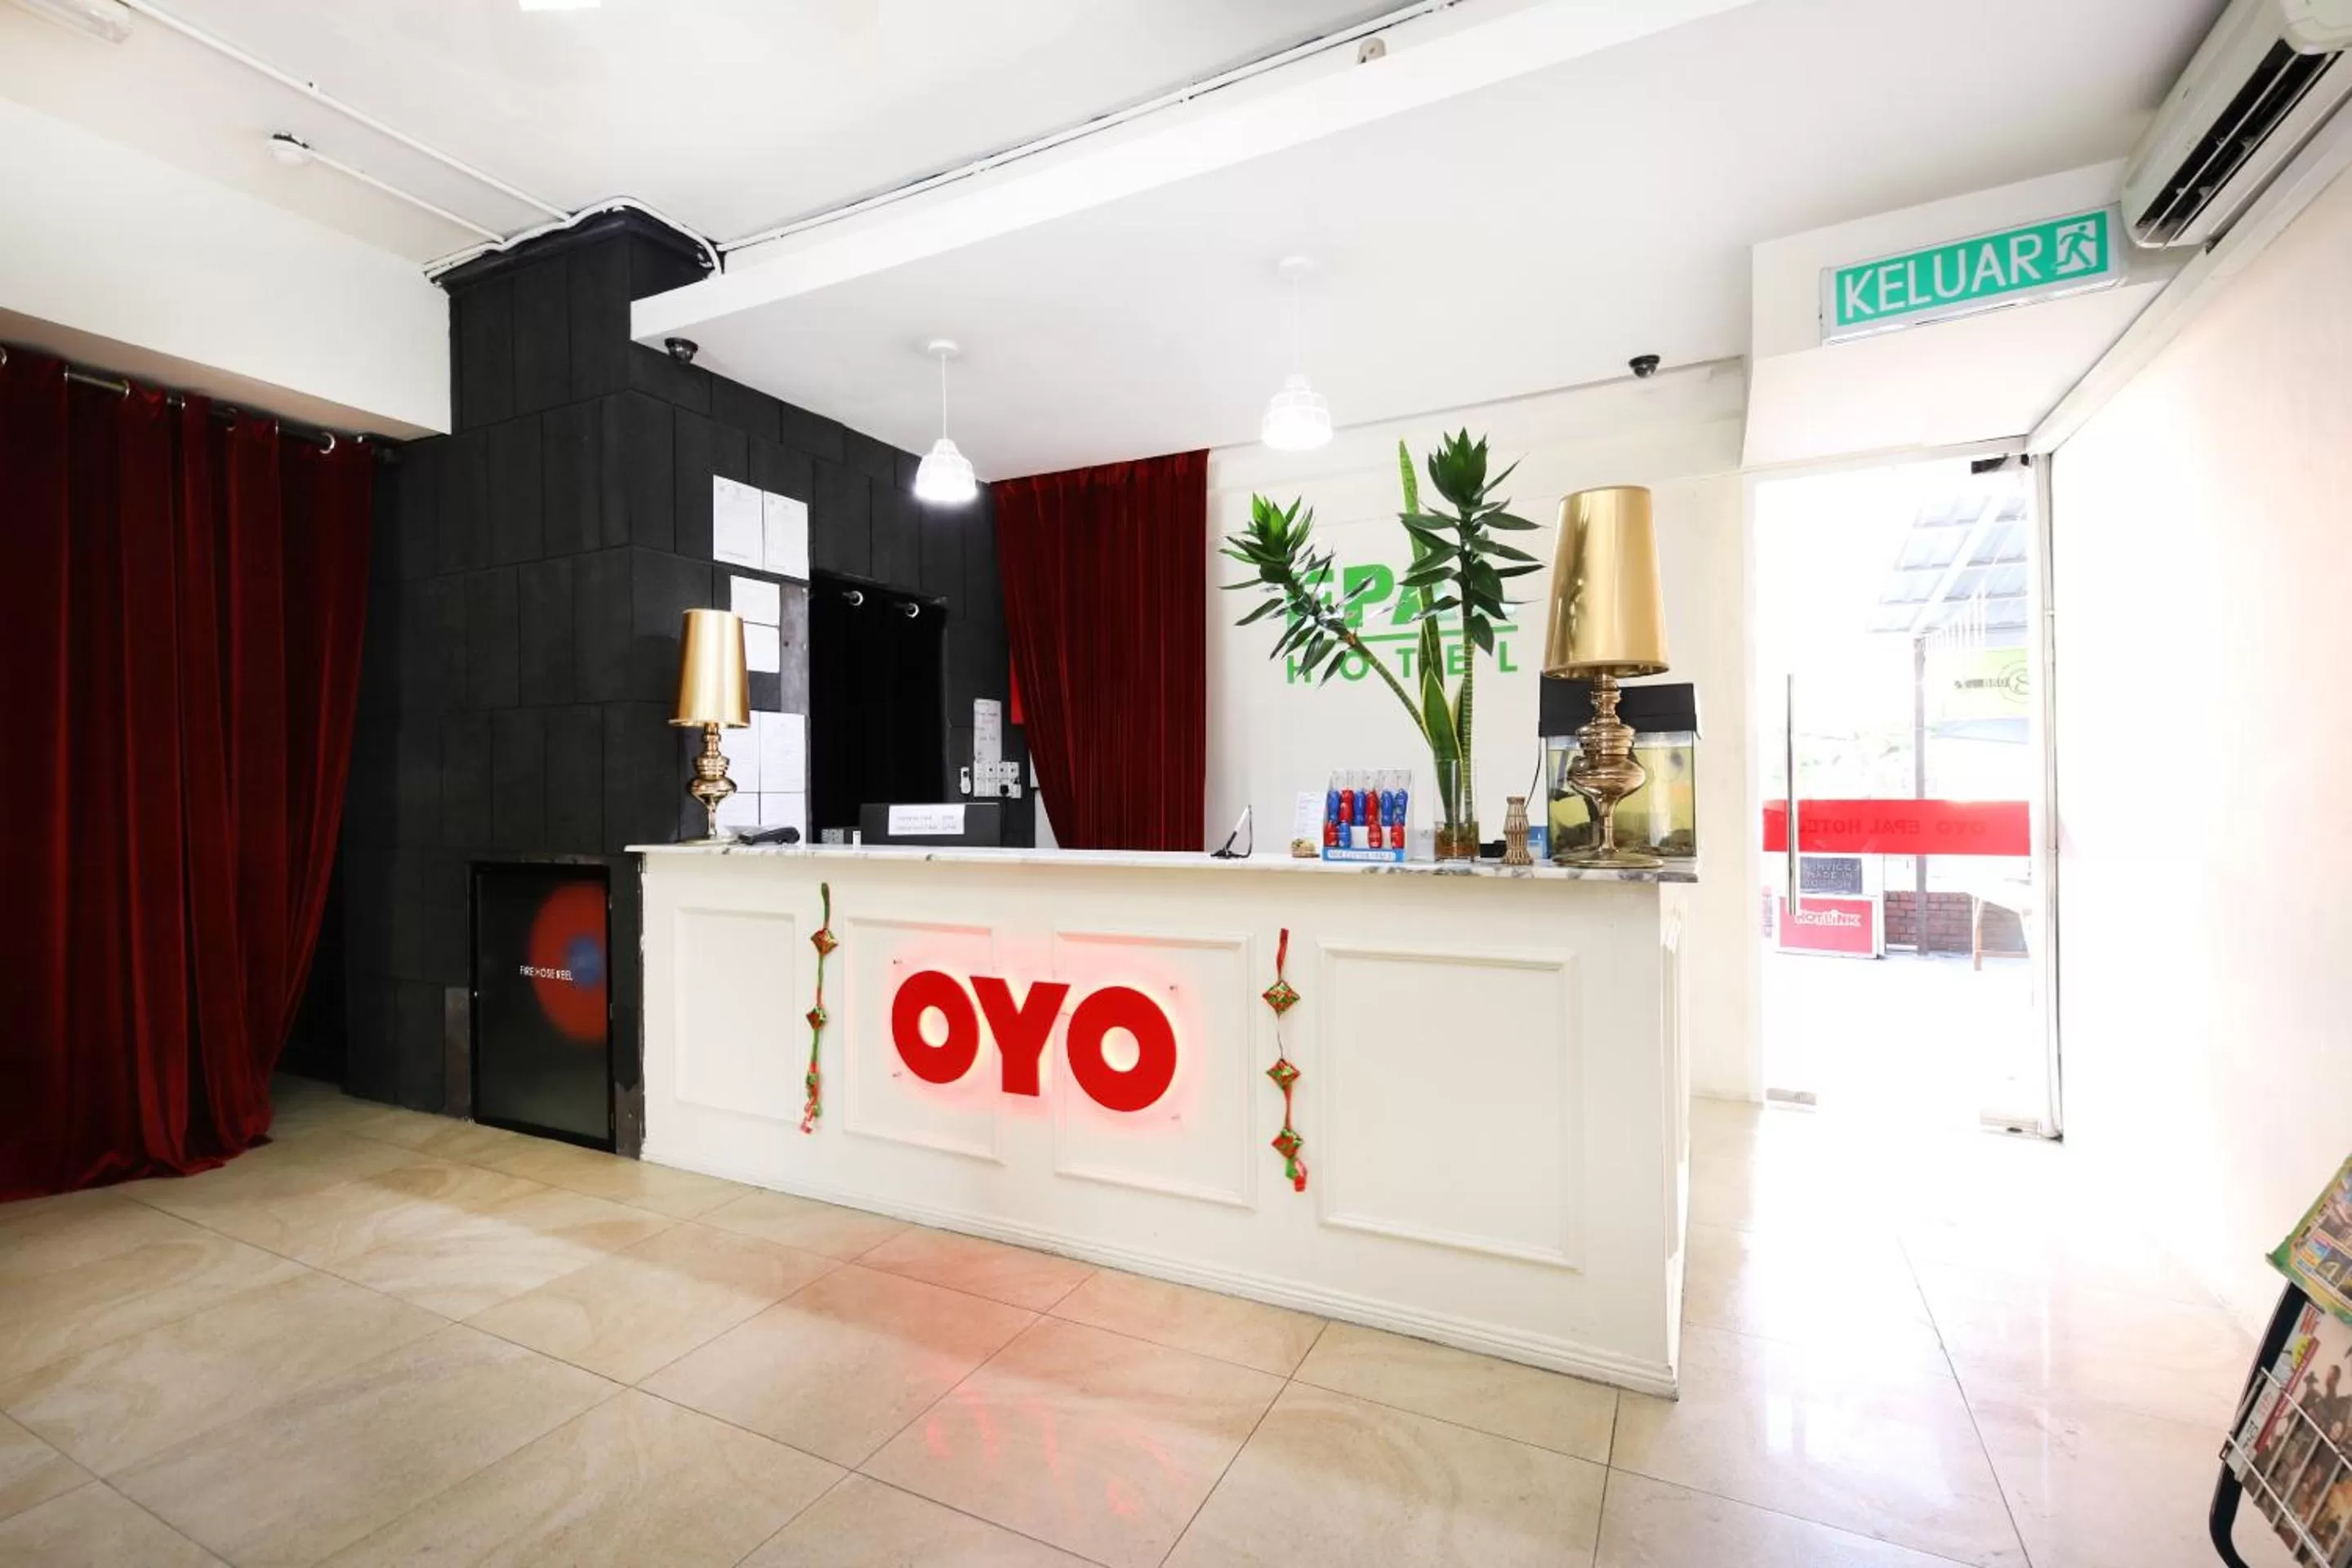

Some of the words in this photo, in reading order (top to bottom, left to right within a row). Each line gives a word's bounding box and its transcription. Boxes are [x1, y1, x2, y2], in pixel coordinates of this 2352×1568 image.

[1843, 234, 2042, 319] KELUAR
[1286, 564, 1517, 630] EPA
[1286, 641, 1518, 684] HOTEL
[892, 970, 1177, 1111] OYO
